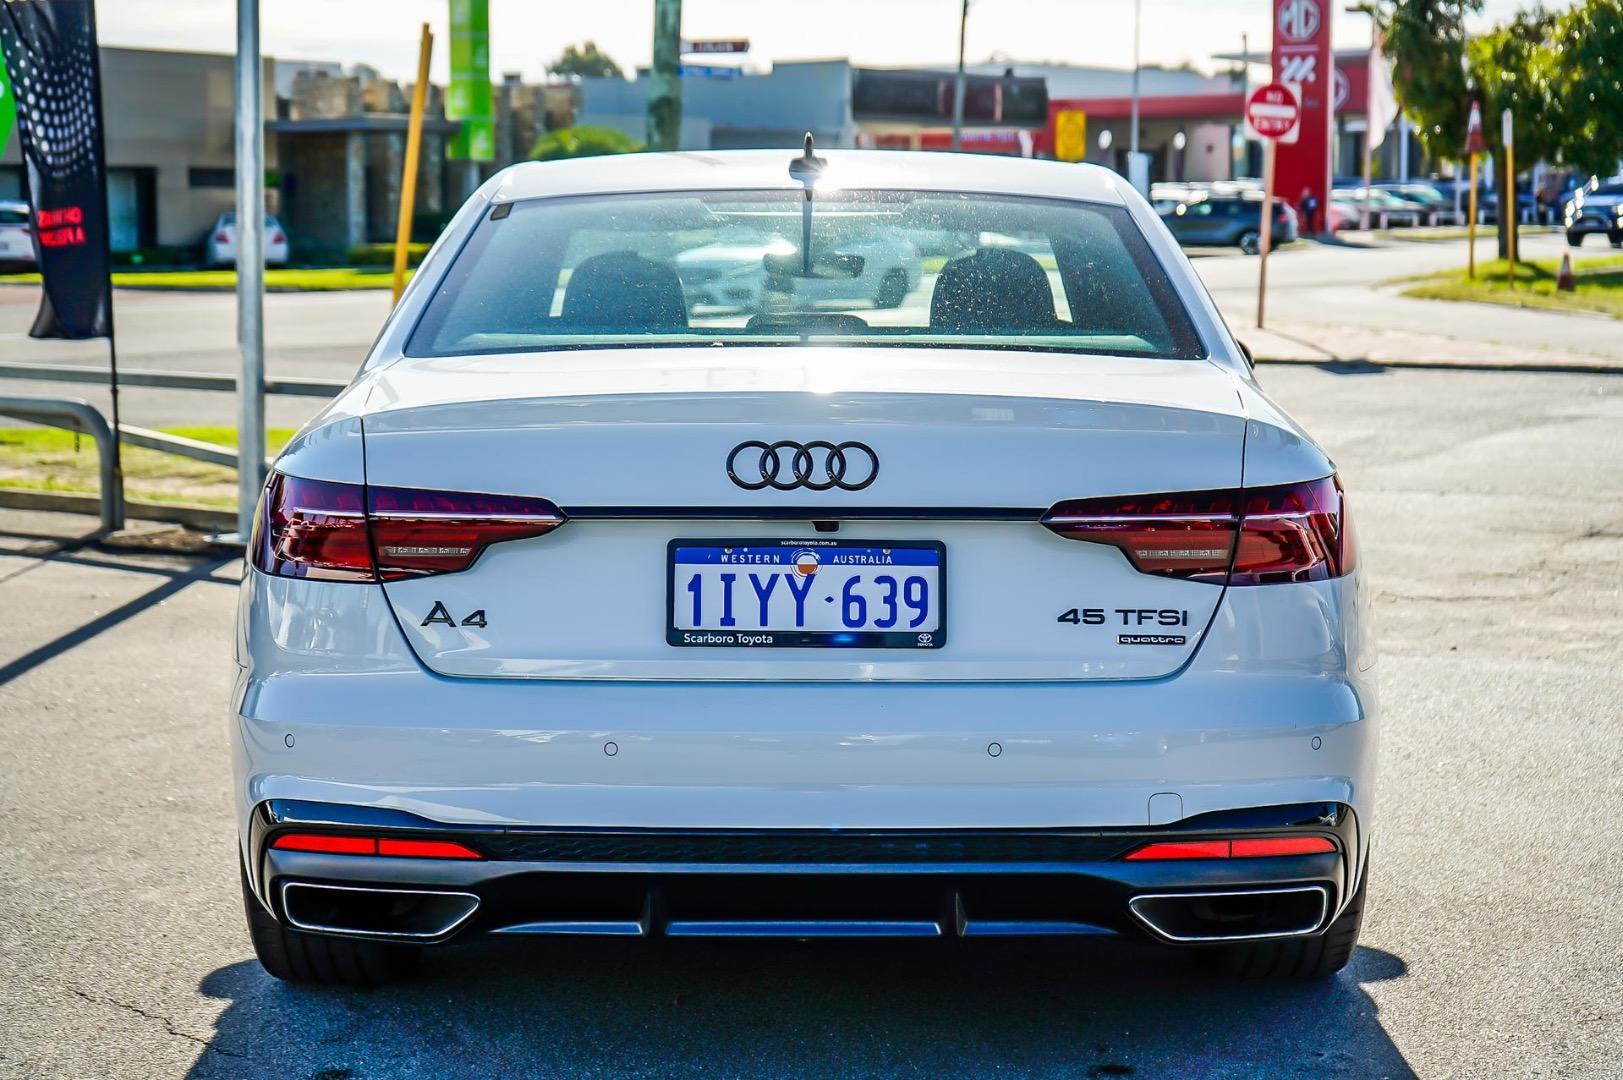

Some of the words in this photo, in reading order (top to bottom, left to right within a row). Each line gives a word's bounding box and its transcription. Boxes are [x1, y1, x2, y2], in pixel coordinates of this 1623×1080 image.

[720, 554, 781, 564] WESTERN
[833, 555, 893, 565] AUSTRALIA
[1057, 608, 1106, 625] 45
[1114, 609, 1188, 627] TFSI
[683, 633, 734, 644] Scarboro
[736, 633, 773, 646] Toyota
[1120, 636, 1184, 645] quattro
